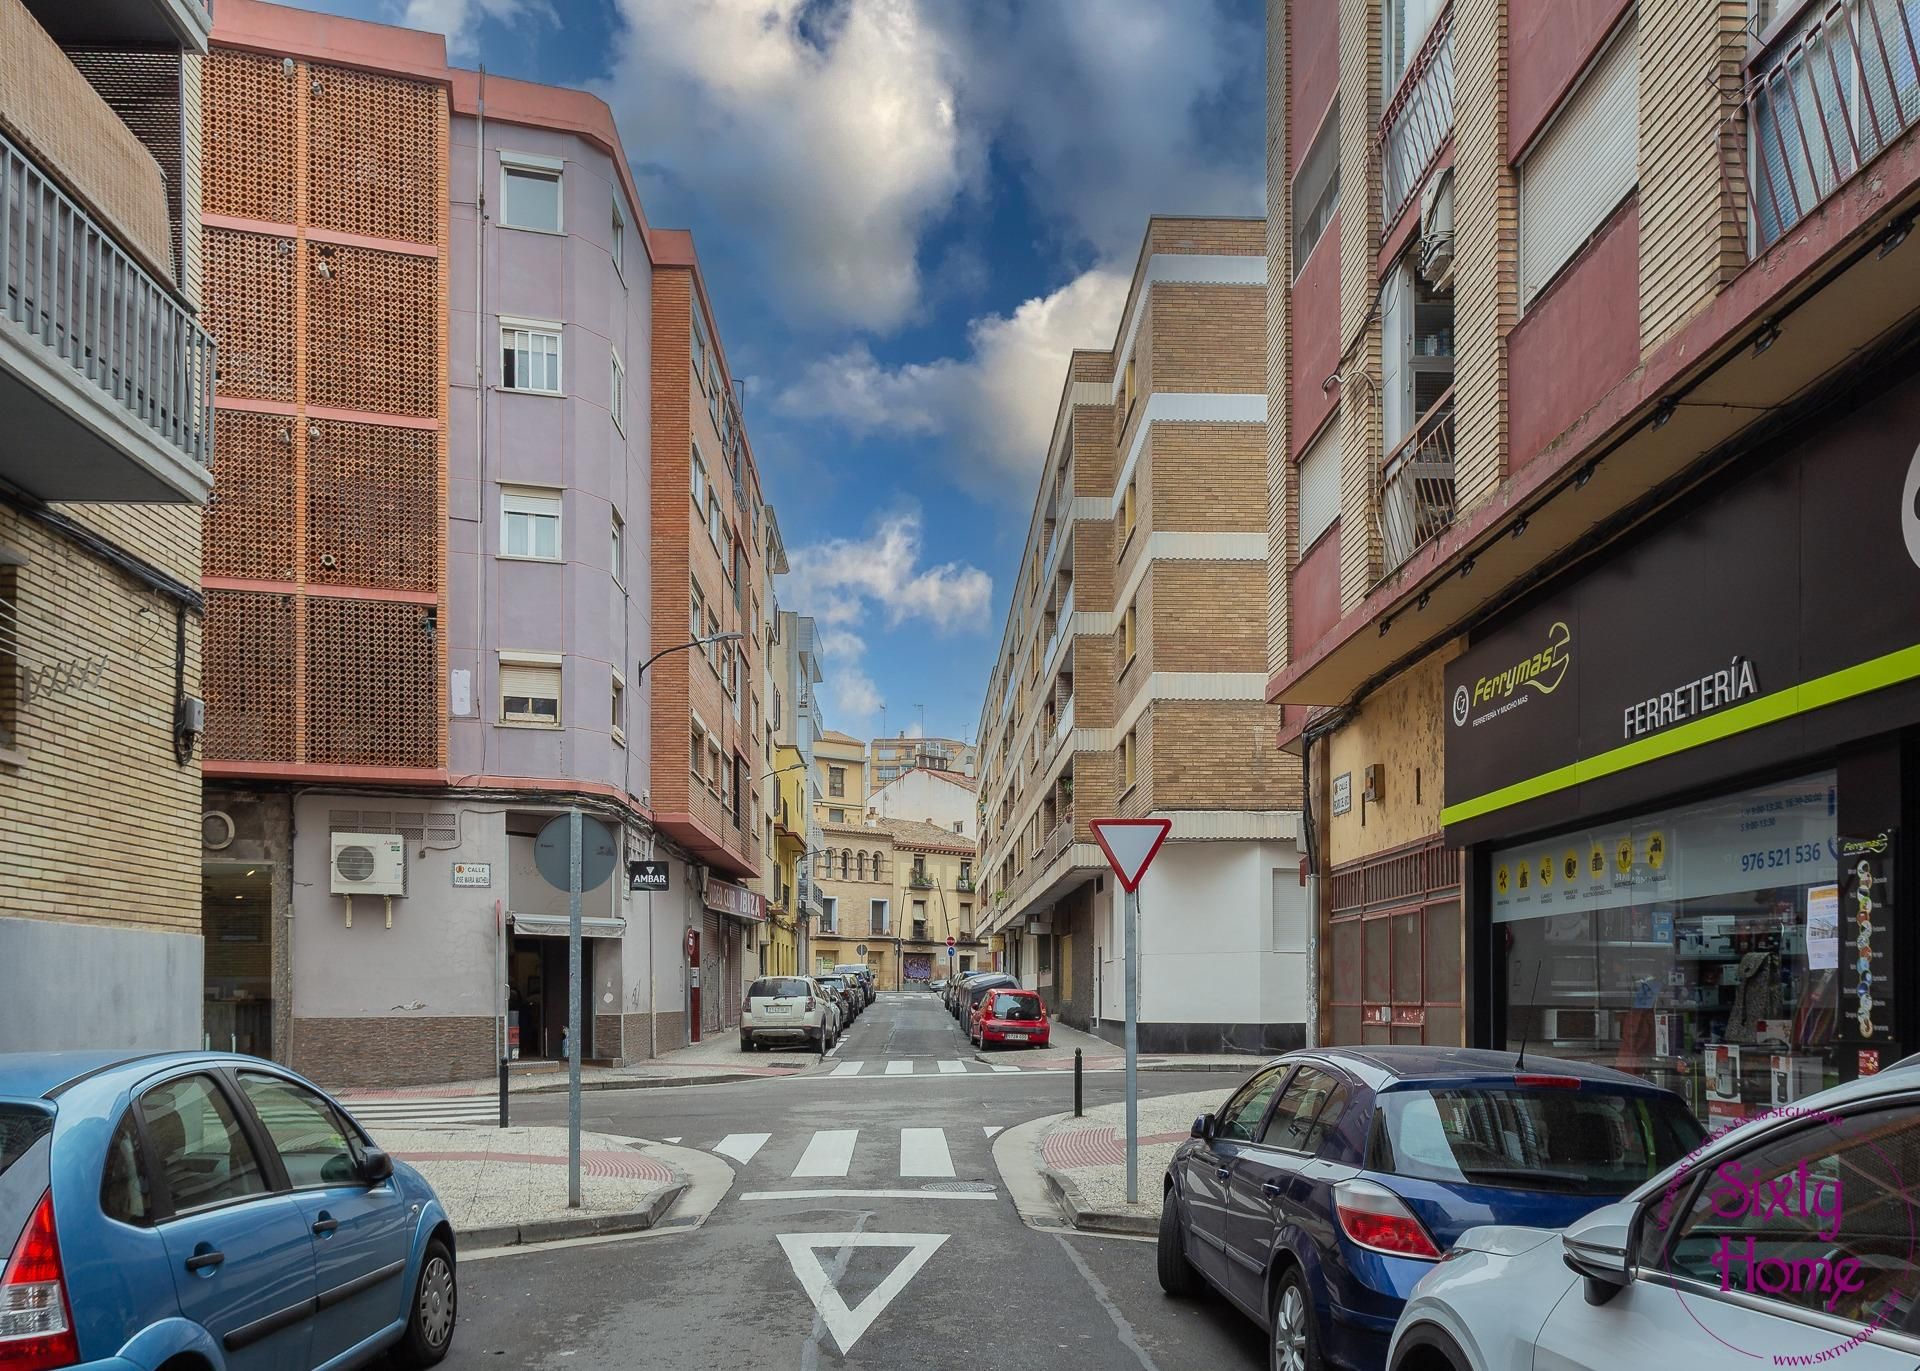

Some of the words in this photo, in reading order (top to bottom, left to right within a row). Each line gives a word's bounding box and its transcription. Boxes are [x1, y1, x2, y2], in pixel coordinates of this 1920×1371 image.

[1473, 646, 1554, 707] Ferrymas
[1624, 655, 1757, 739] FERRETERÍA
[1742, 852, 1764, 872] 976
[1768, 847, 1790, 868] 521
[1796, 842, 1821, 864] 536
[633, 874, 666, 883] AMBAR
[708, 883, 723, 905] VIDEO
[724, 887, 736, 909] CLUB
[740, 890, 761, 917] IBIZA
